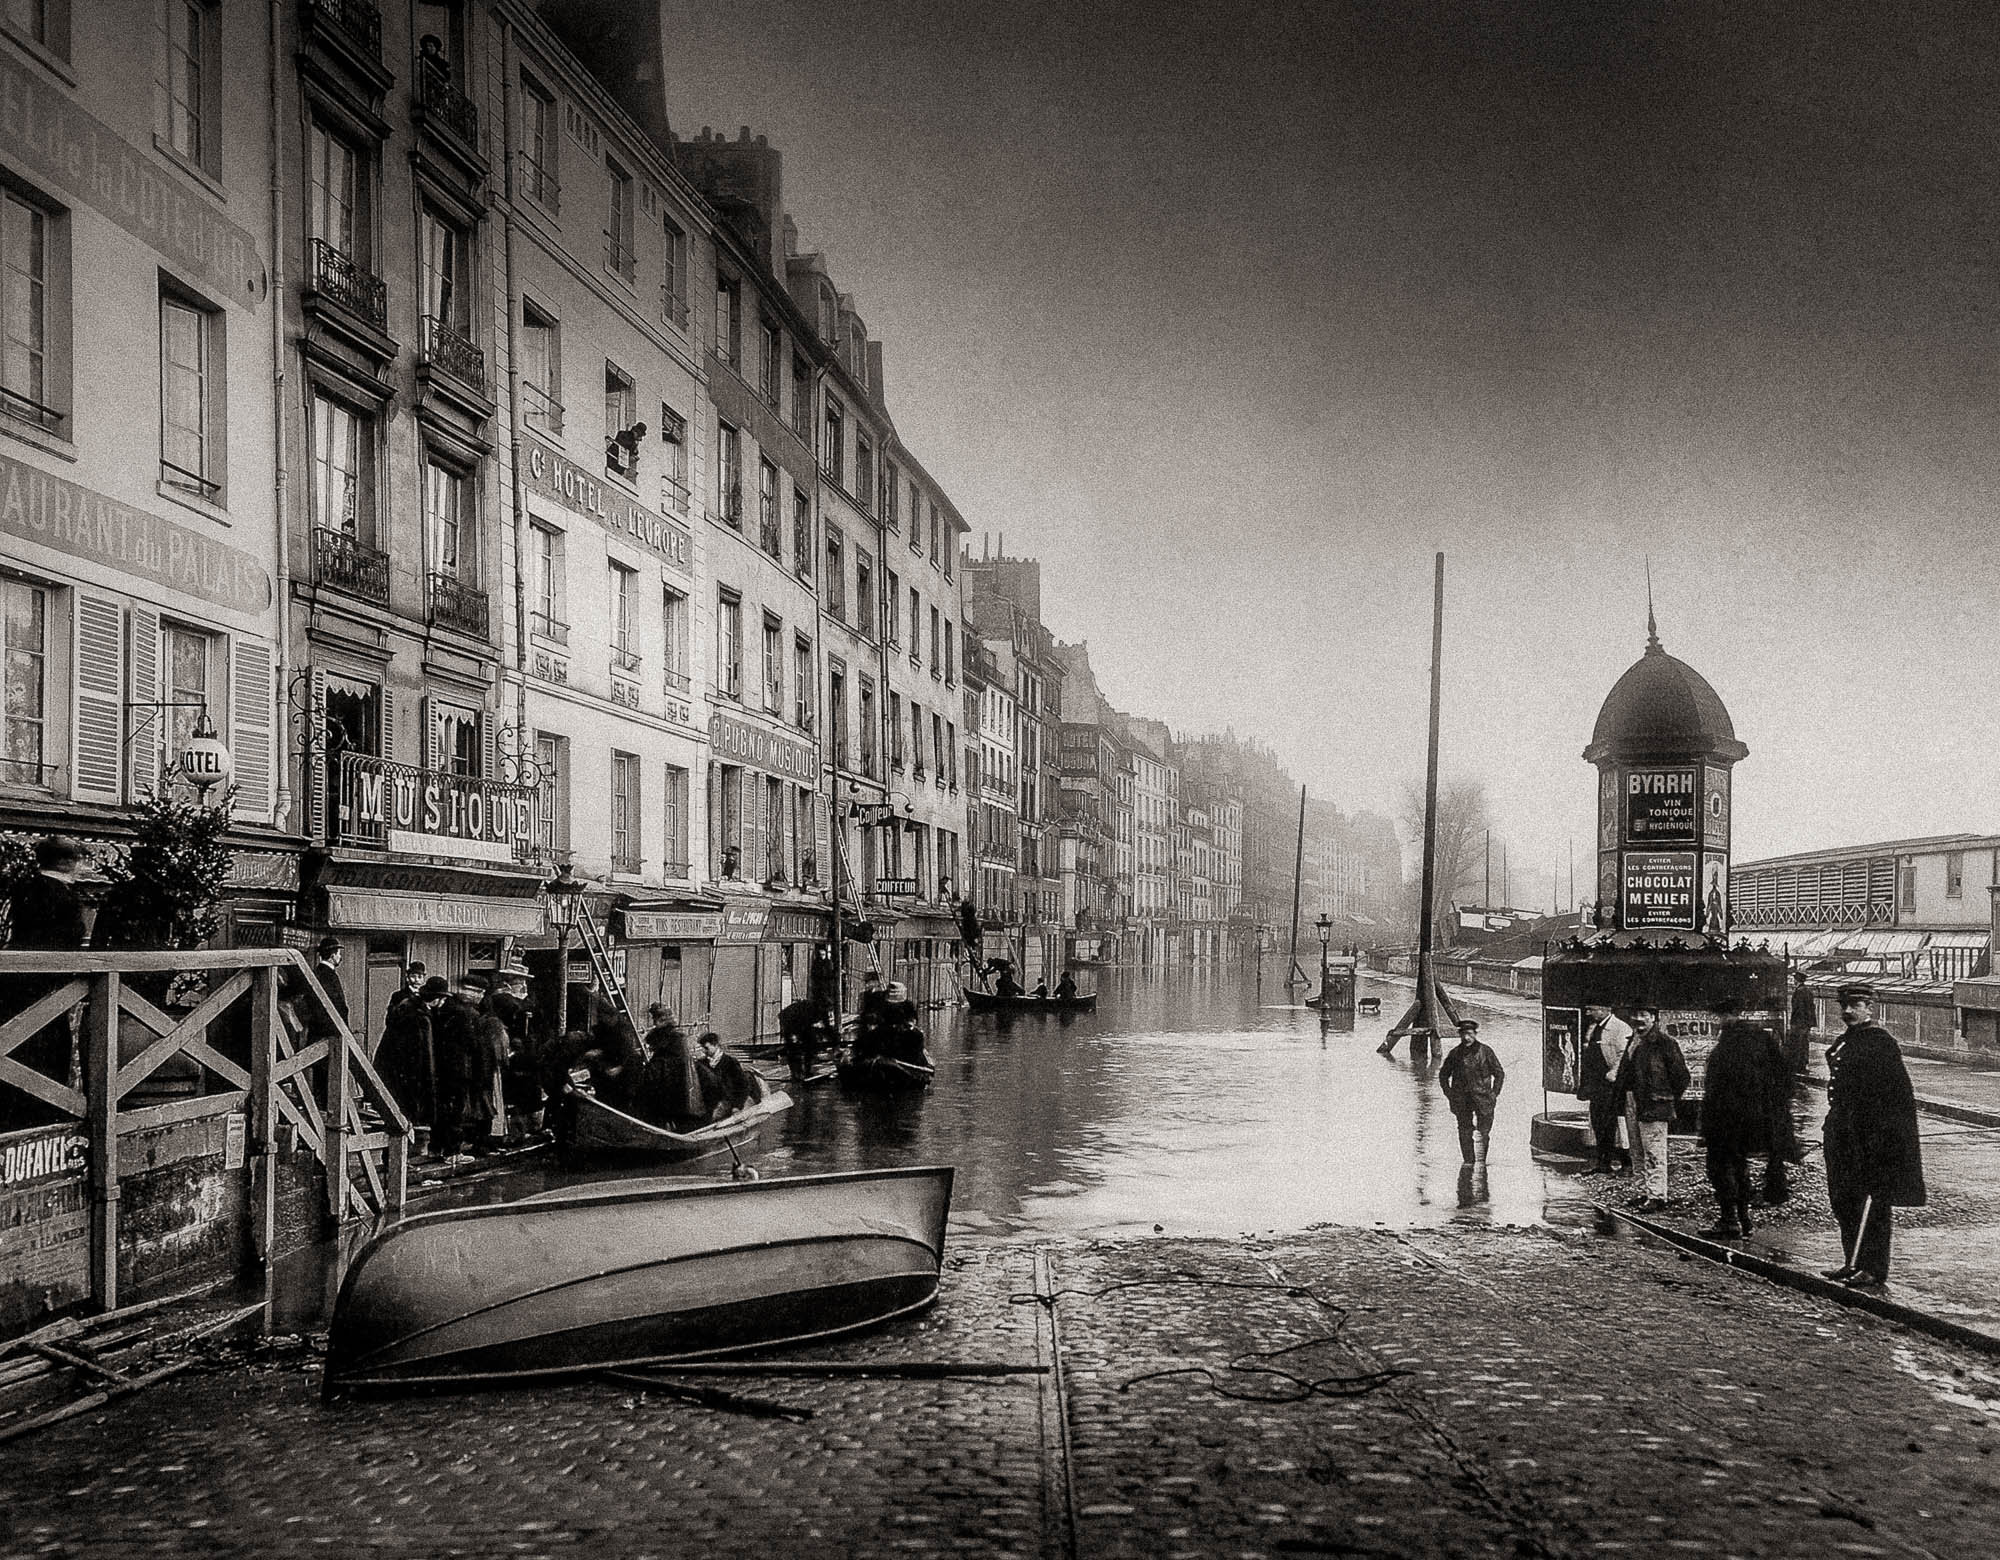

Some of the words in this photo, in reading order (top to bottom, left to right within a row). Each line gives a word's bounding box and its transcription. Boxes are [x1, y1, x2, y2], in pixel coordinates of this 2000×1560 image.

[0, 463, 133, 561] AURANT
[135, 518, 162, 573] du
[169, 528, 264, 602] PALAIS
[769, 740, 814, 778] MUSIQUE
[1629, 774, 1693, 794] BYRRH
[360, 771, 530, 840] MUSIQUE
[1650, 808, 1693, 817] TONIQUE
[1664, 799, 1681, 807] VIN
[860, 805, 894, 826] Coiffeur
[876, 881, 916, 893] COIFFEUR
[1627, 876, 1692, 888] CHOCOLAT
[1630, 893, 1689, 905] MENIER
[4, 1135, 67, 1183] DUFAYEL
